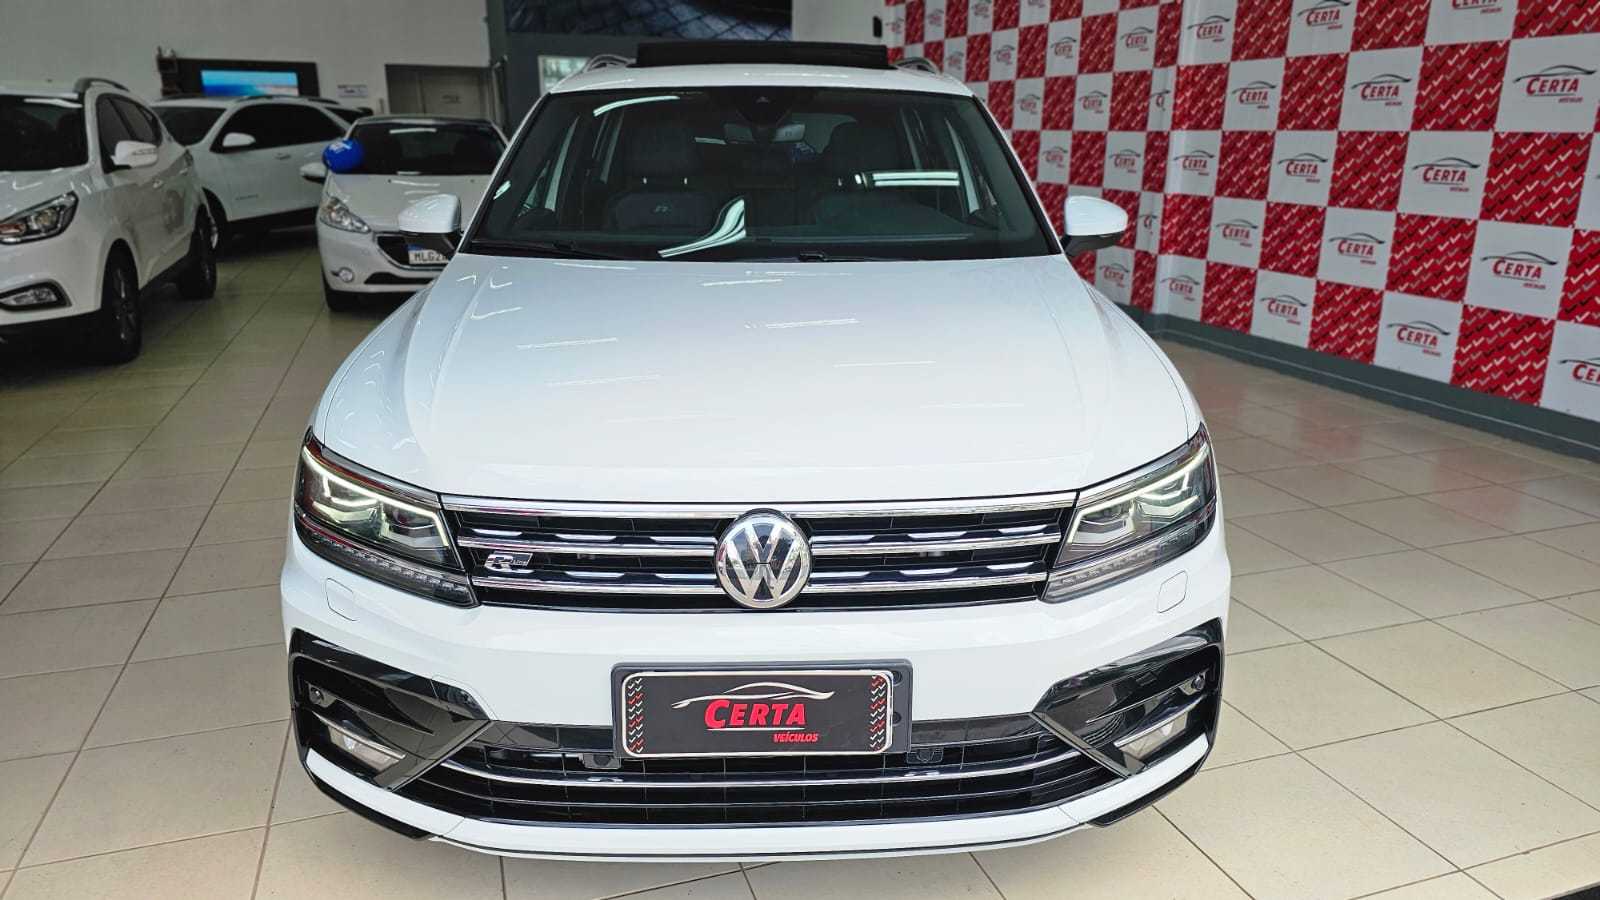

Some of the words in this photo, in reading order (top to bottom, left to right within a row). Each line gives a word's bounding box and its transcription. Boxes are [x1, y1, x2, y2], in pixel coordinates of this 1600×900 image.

[1306, 9, 1341, 27] CERTA
[1196, 24, 1223, 39] CERTA
[1361, 83, 1399, 100] CERTA
[1526, 76, 1579, 96] CERTA
[1239, 88, 1268, 104] CERTA
[1182, 154, 1207, 170] CERTA
[1285, 159, 1318, 176] CERTA
[1423, 166, 1467, 183] CERTA
[1222, 223, 1250, 240] CERTA
[1338, 240, 1374, 256] CERTA
[1493, 259, 1542, 279] CERTA
[1169, 278, 1193, 295] CERTA
[1267, 300, 1299, 317] CERTA
[1397, 327, 1438, 348] CERTA
[704, 699, 806, 729] CERTA
[773, 731, 819, 743] VEÍCULOS
